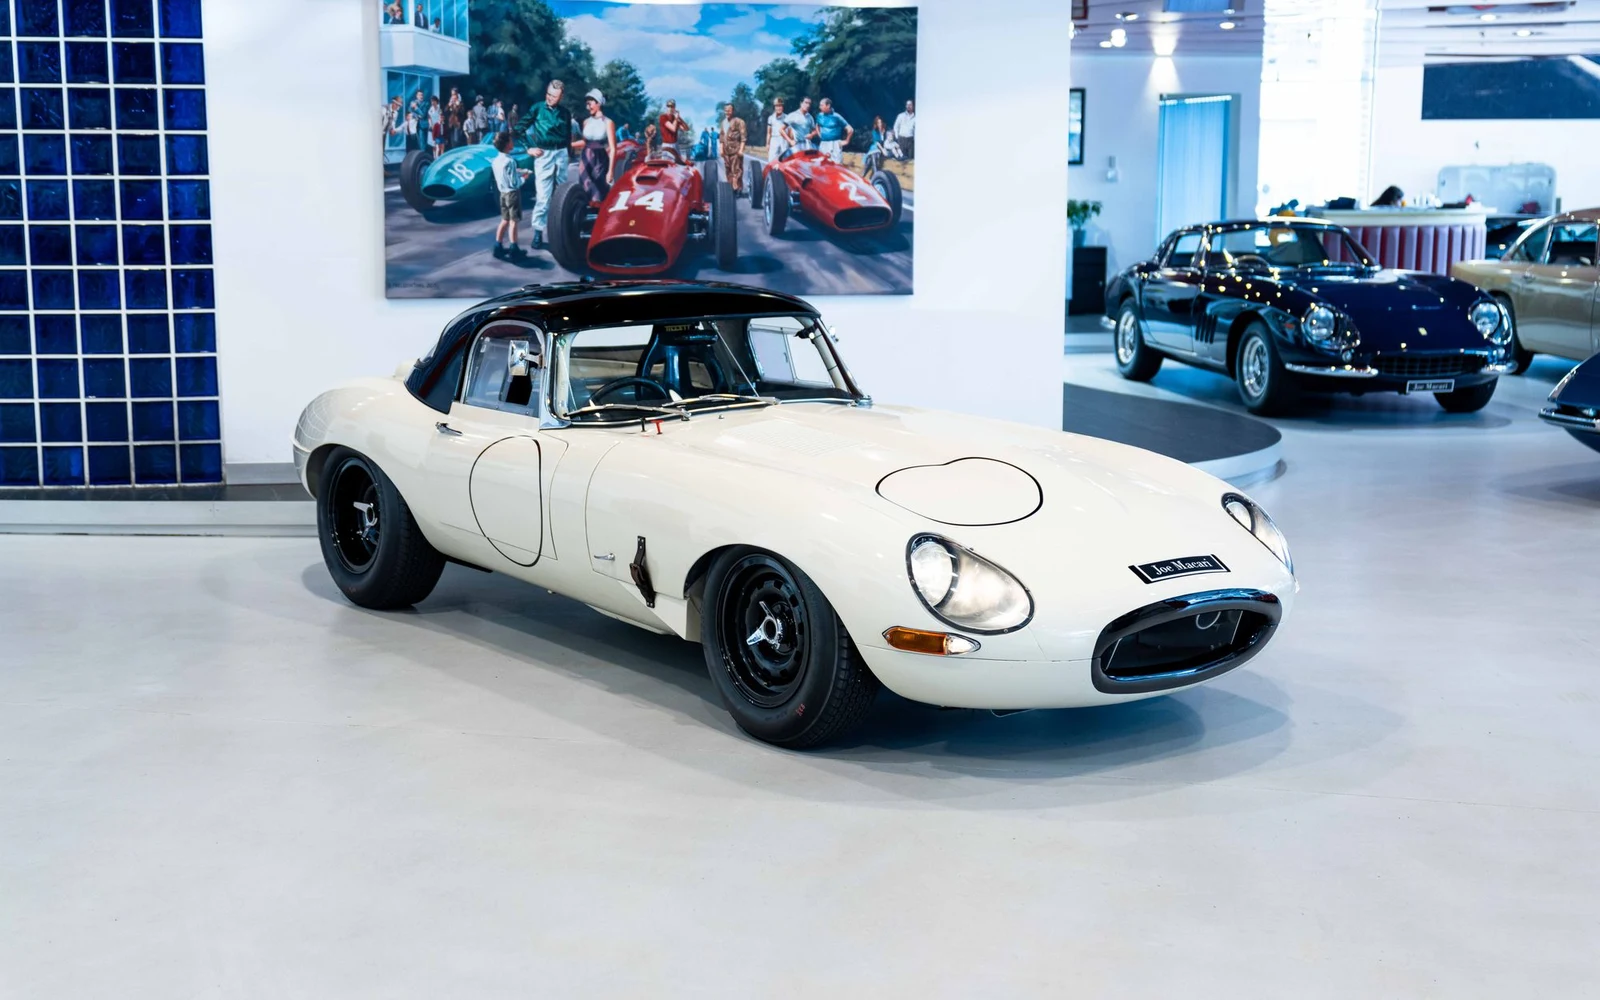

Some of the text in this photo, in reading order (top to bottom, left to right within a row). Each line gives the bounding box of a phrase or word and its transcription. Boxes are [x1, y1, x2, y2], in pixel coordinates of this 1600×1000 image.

[448, 163, 475, 182] 18
[608, 190, 664, 212] 14
[839, 182, 867, 201] 2
[1151, 558, 1213, 576] Joe Macari
